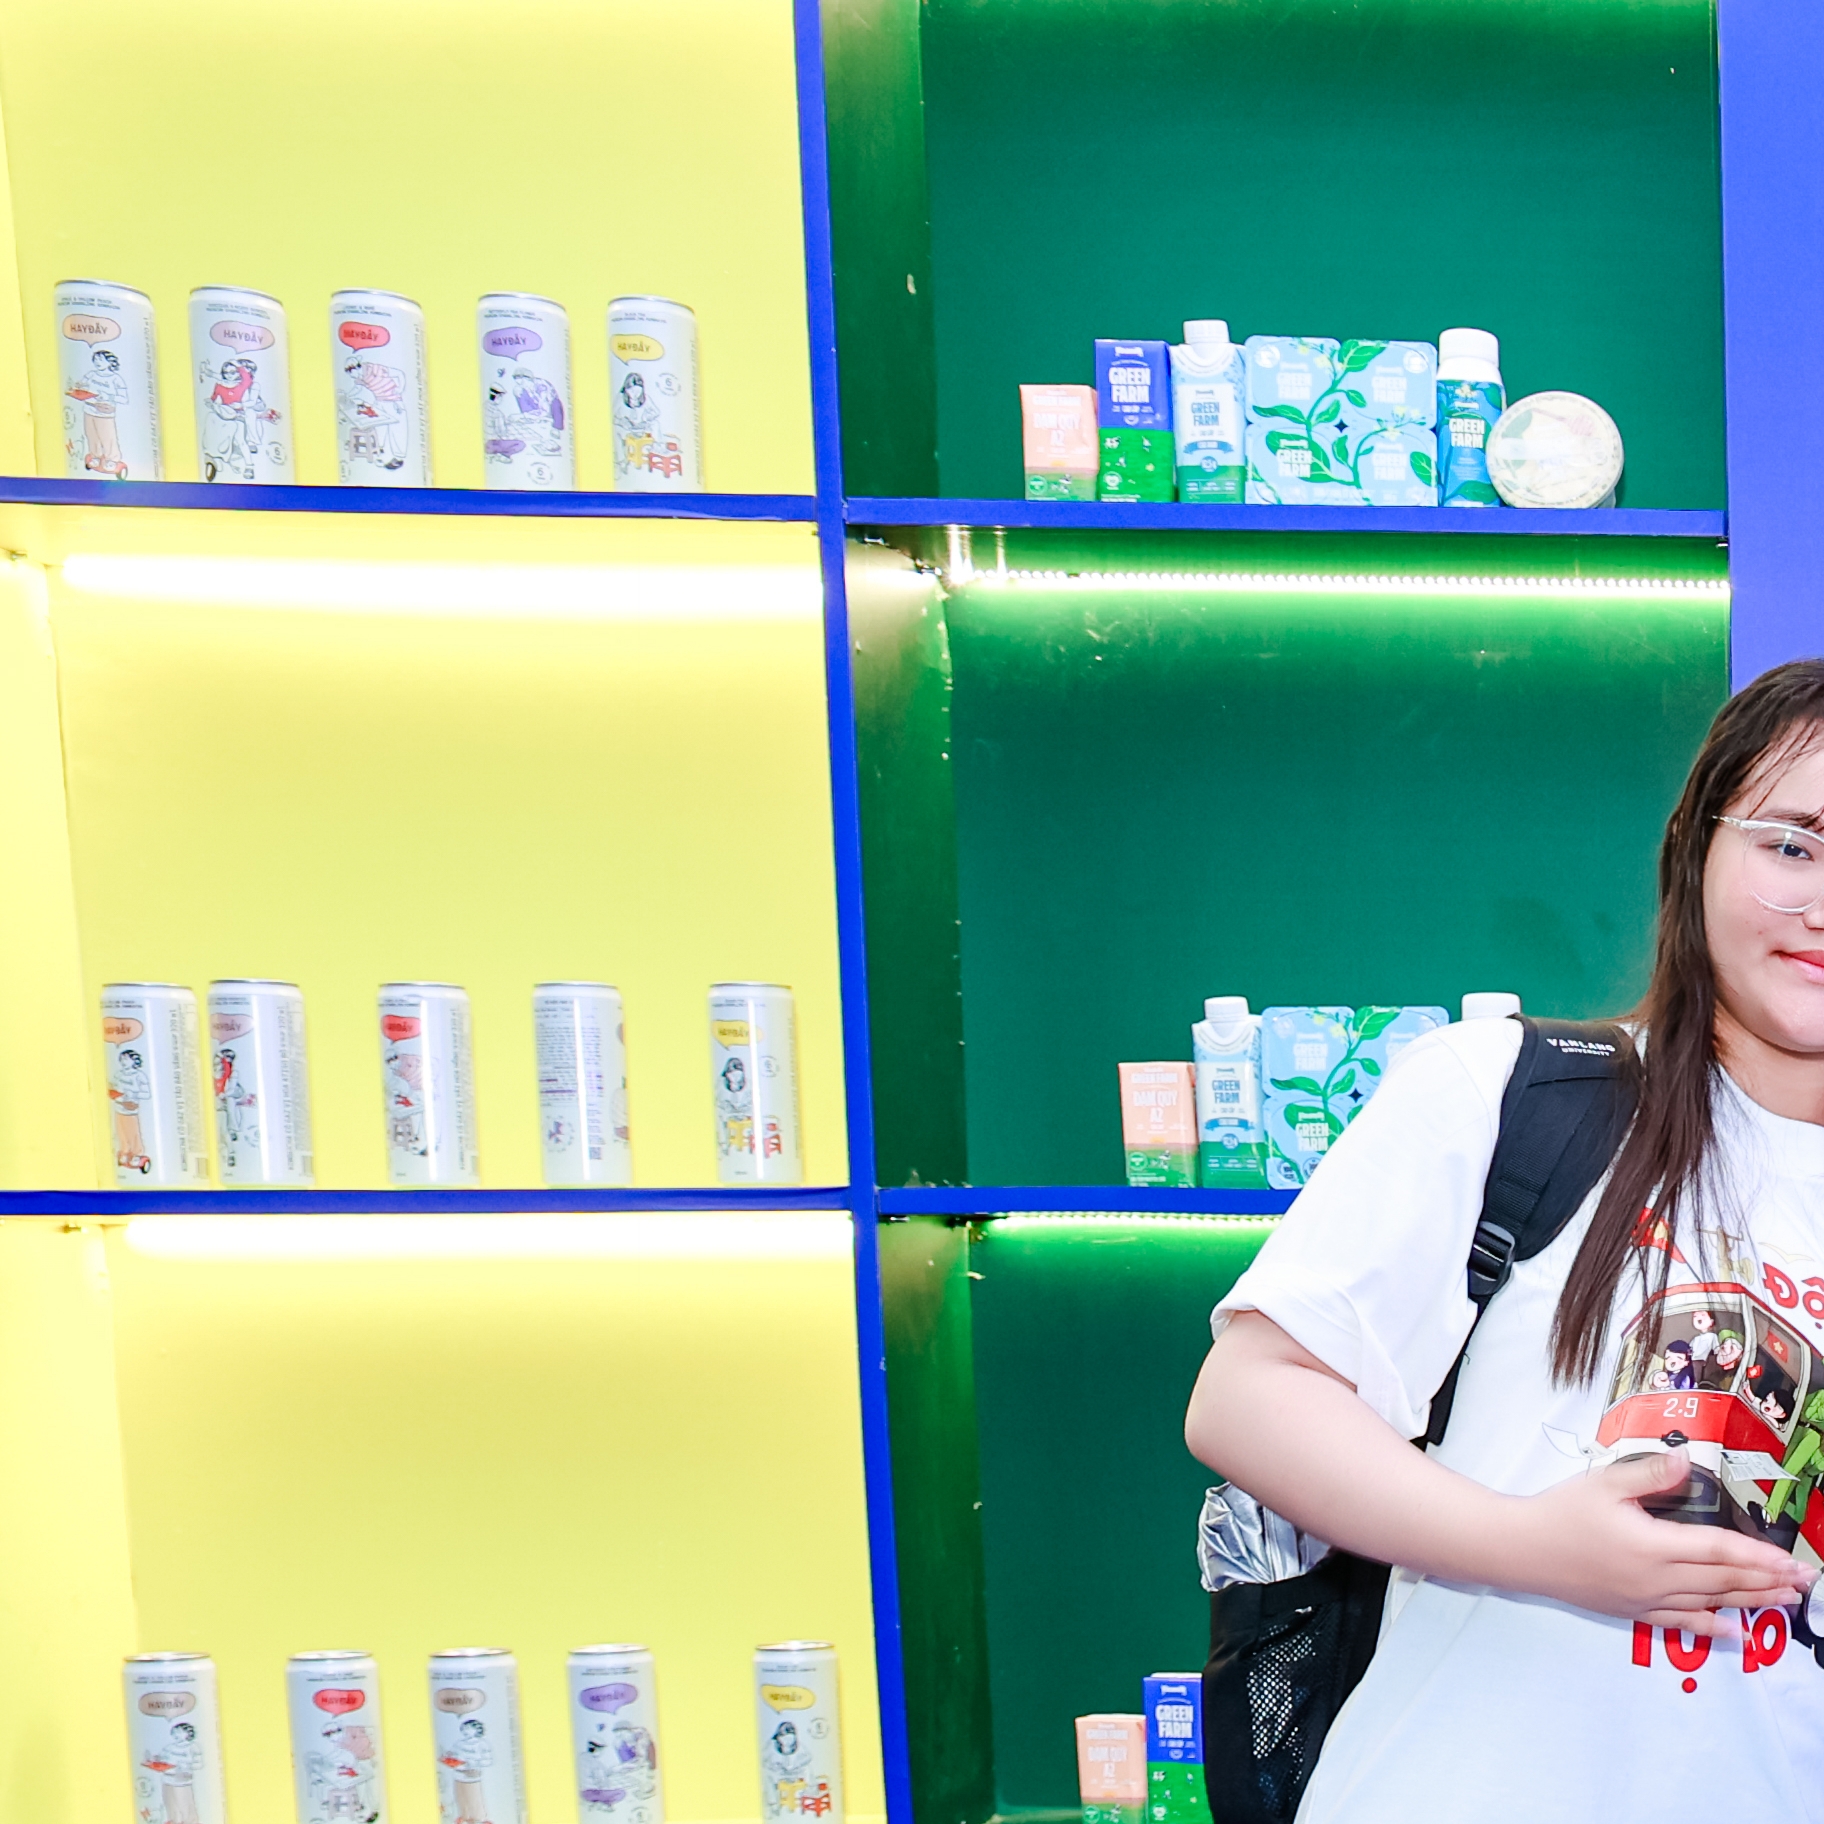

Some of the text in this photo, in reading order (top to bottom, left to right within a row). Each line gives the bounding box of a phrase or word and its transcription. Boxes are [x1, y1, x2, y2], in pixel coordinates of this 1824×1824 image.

[1108, 367, 1151, 386] GREEN
[1110, 385, 1150, 404] FARM
[1448, 418, 1485, 434] GREEN
[1450, 433, 1485, 449] FARM
[1546, 1038, 1616, 1053] VANLANG
[1561, 1047, 1610, 1057] UNIVERSITY
[1155, 1704, 1194, 1721] GREEN
[1157, 1720, 1193, 1739] FARM
